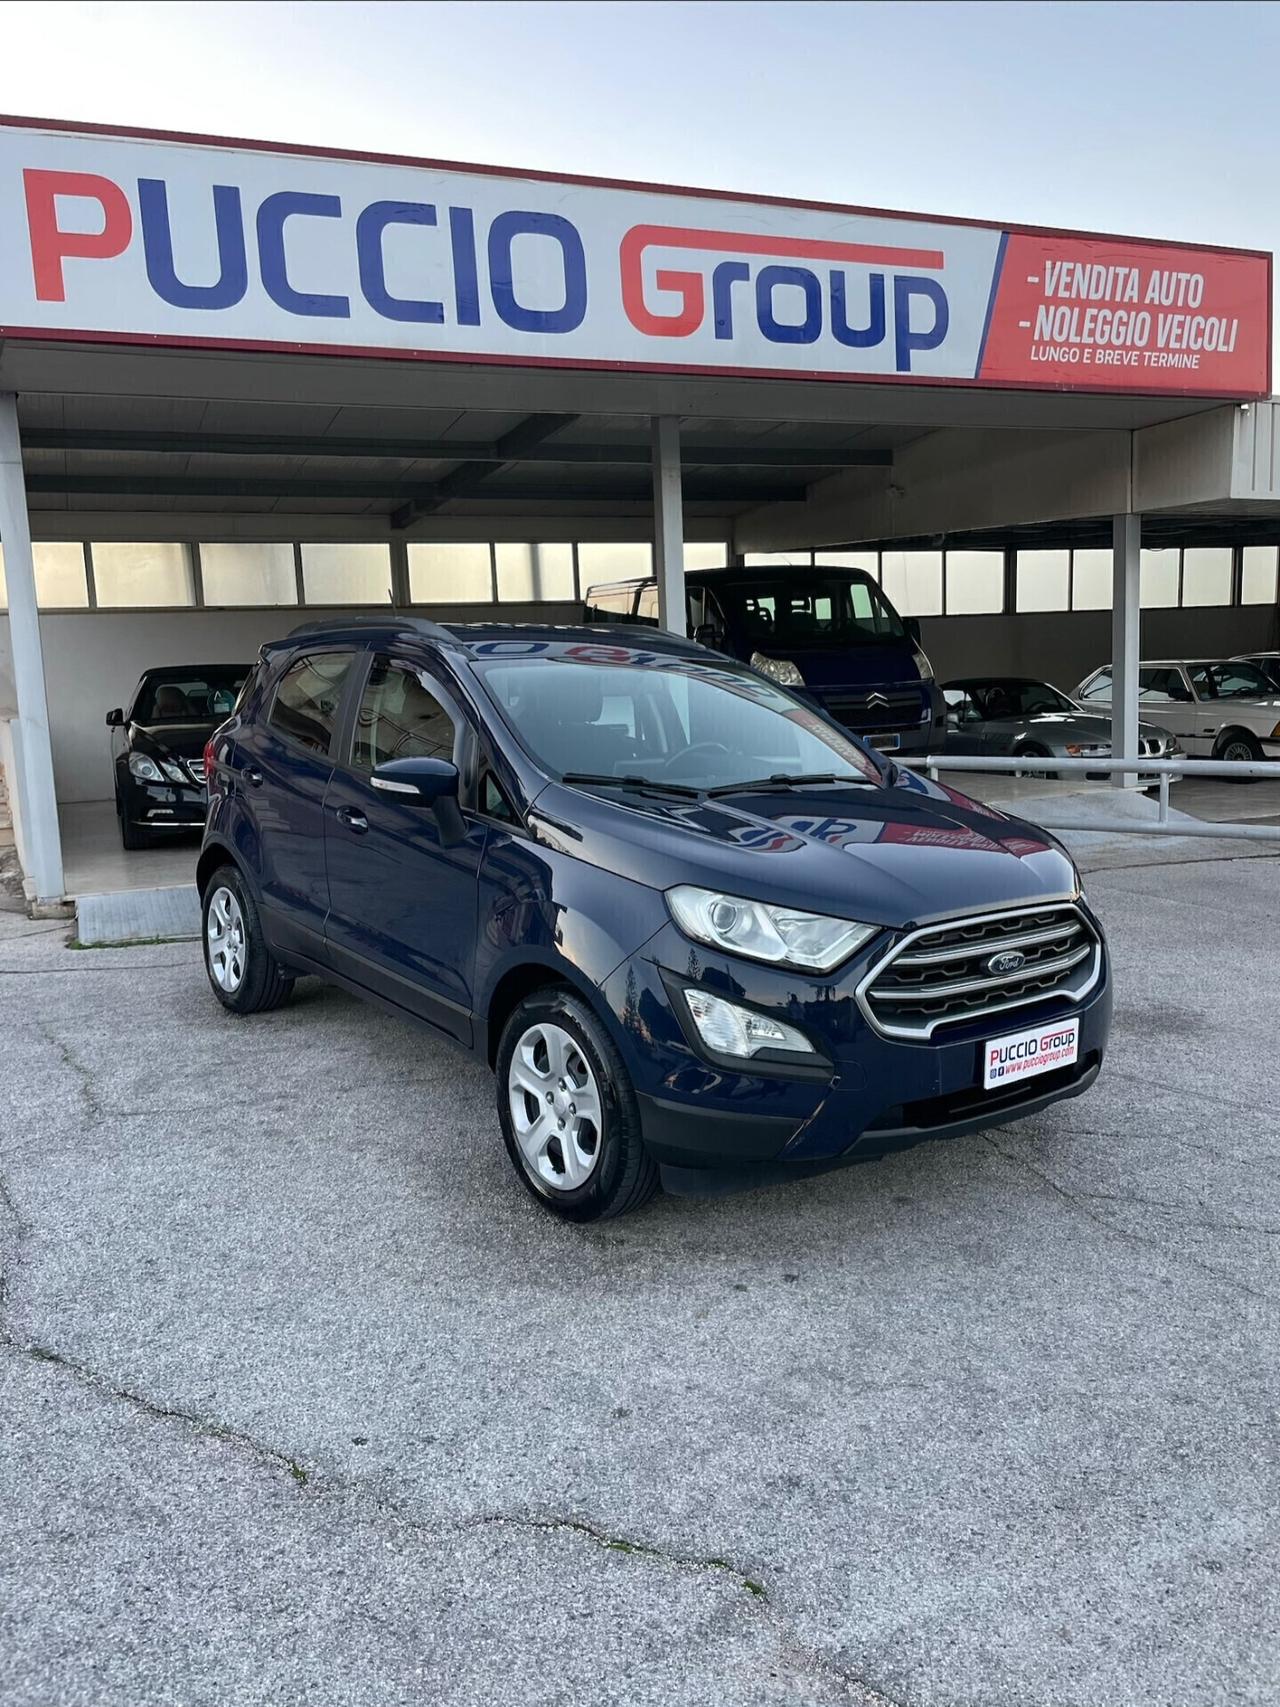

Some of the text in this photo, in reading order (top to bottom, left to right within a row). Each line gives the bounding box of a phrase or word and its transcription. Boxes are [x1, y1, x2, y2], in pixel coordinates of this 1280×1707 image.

[22, 167, 588, 335] PUCCIO
[1143, 269, 1205, 309] AUTO
[1156, 312, 1239, 353] VEICOLI
[1030, 344, 1201, 369] LUNGO E BREVE TERMINE
[999, 955, 1020, 970] Ford
[990, 1038, 1038, 1067] PUCCIO
[1005, 1046, 1075, 1075] www.pucciogroup.com
